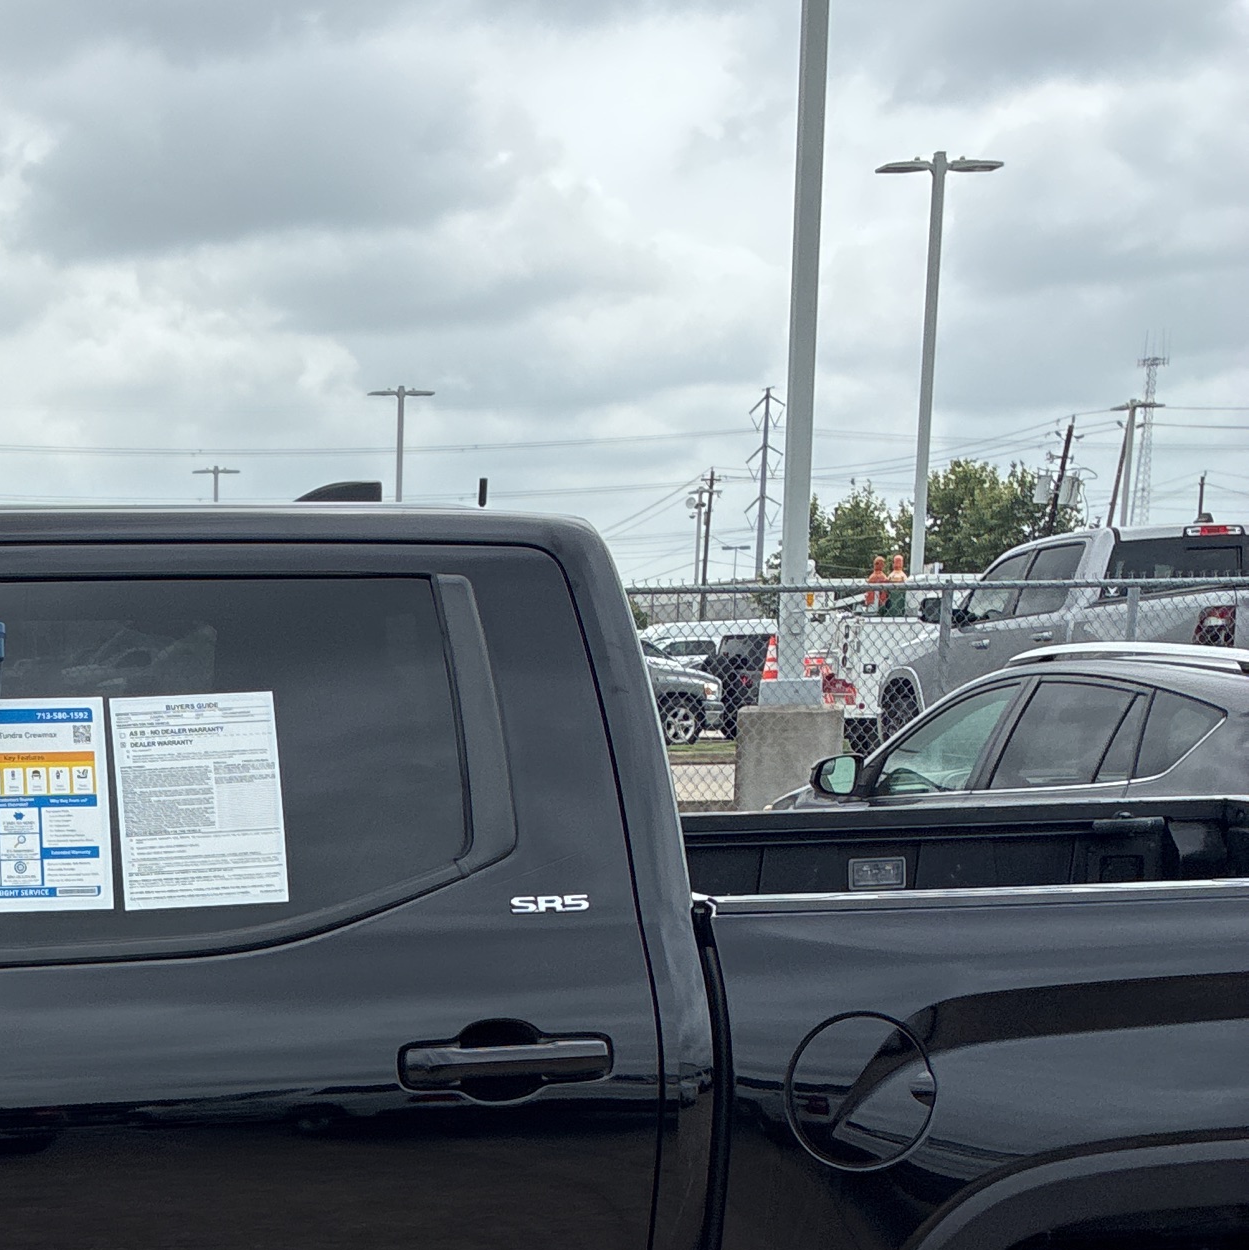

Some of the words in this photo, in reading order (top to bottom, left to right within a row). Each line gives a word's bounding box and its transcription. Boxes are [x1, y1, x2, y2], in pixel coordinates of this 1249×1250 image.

[165, 703, 195, 711] BUYERS
[36, 711, 89, 720] 713-580-1592
[188, 726, 224, 734] WARRANTY
[157, 739, 193, 747] WARRANTY
[510, 894, 590, 913] SR5
